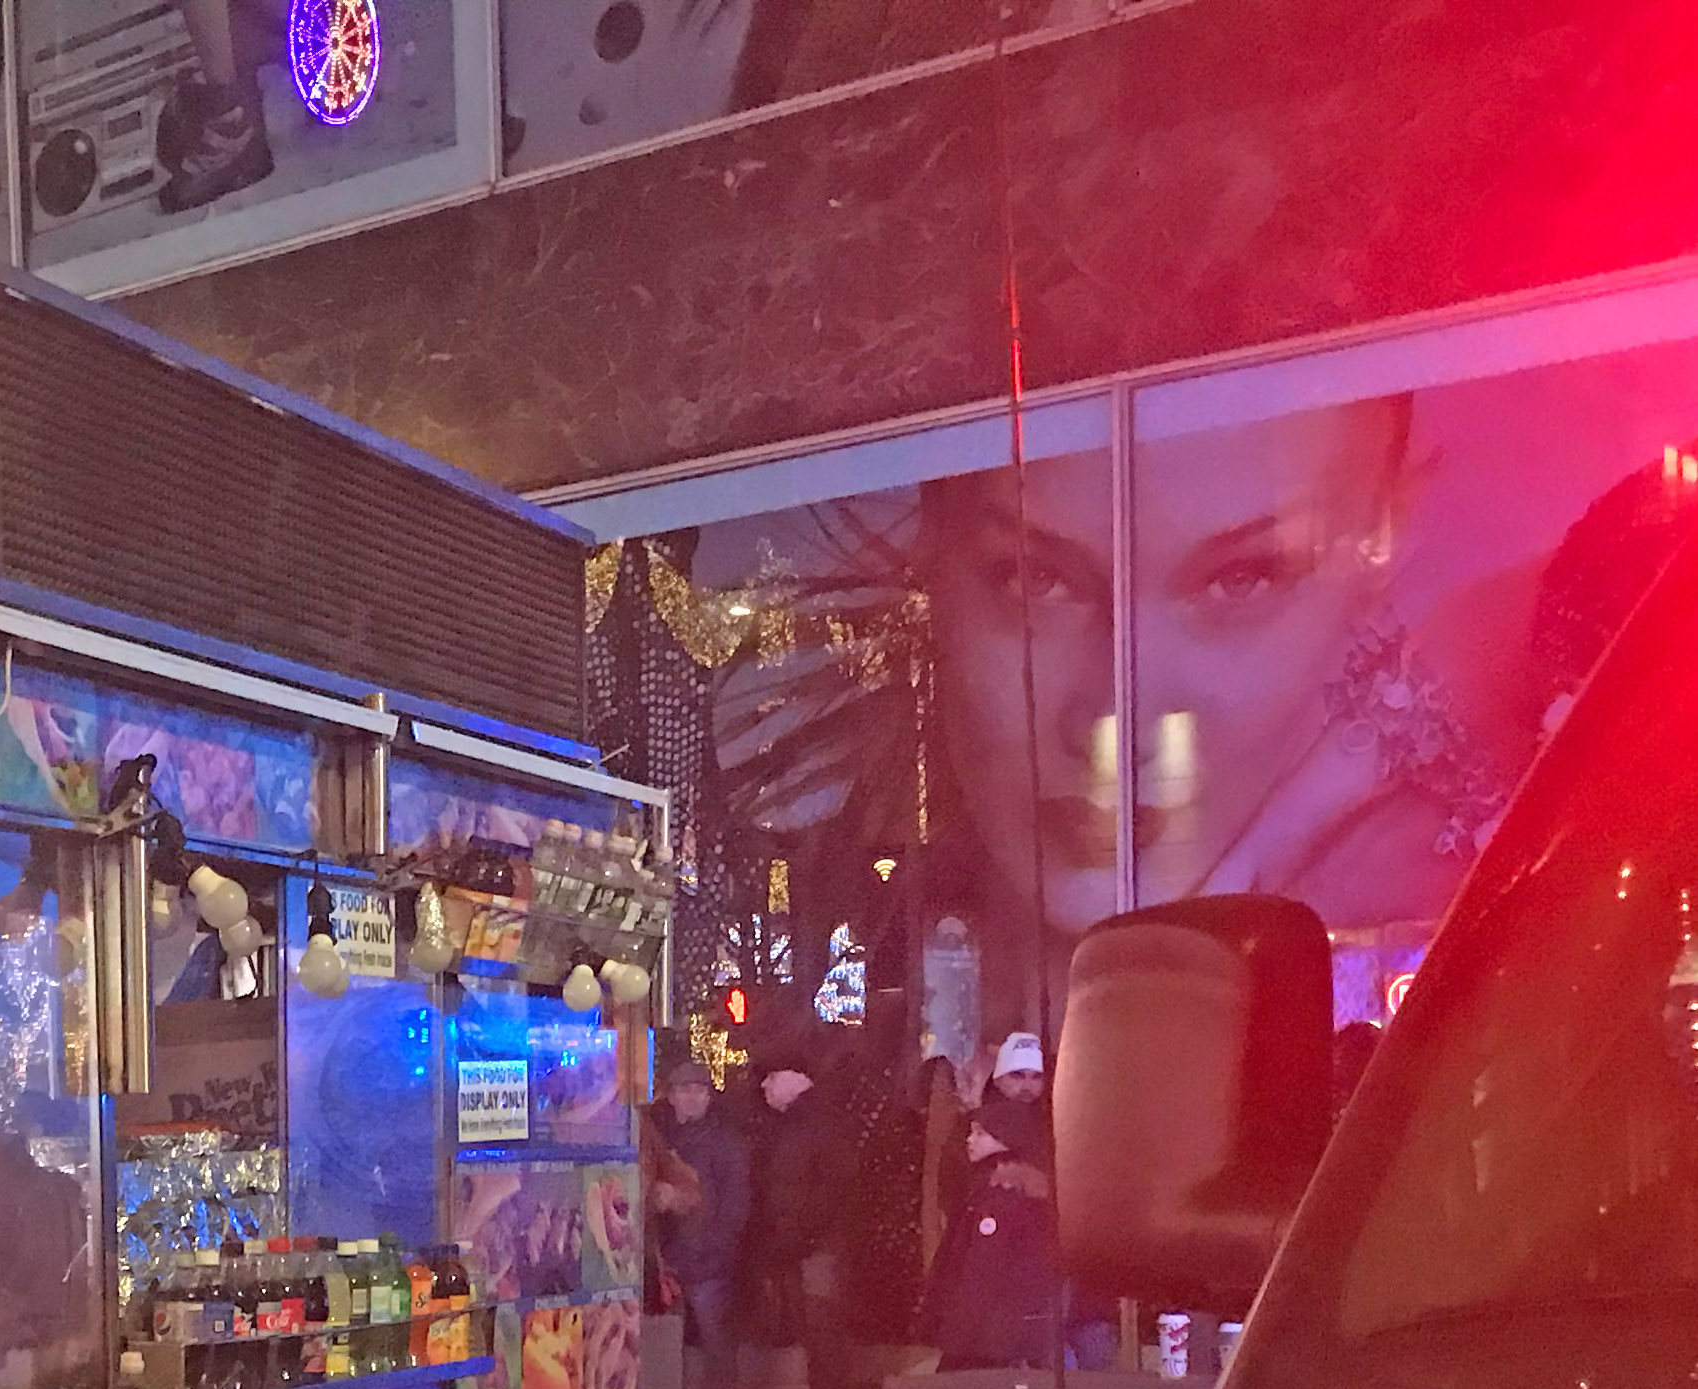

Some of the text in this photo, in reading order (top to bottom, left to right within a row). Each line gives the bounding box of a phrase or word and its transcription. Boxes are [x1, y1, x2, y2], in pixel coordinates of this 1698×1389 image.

[340, 892, 368, 914] FOOD
[330, 917, 392, 944] PLAY ONLY
[460, 1090, 526, 1112] DISPLAY ONLY
